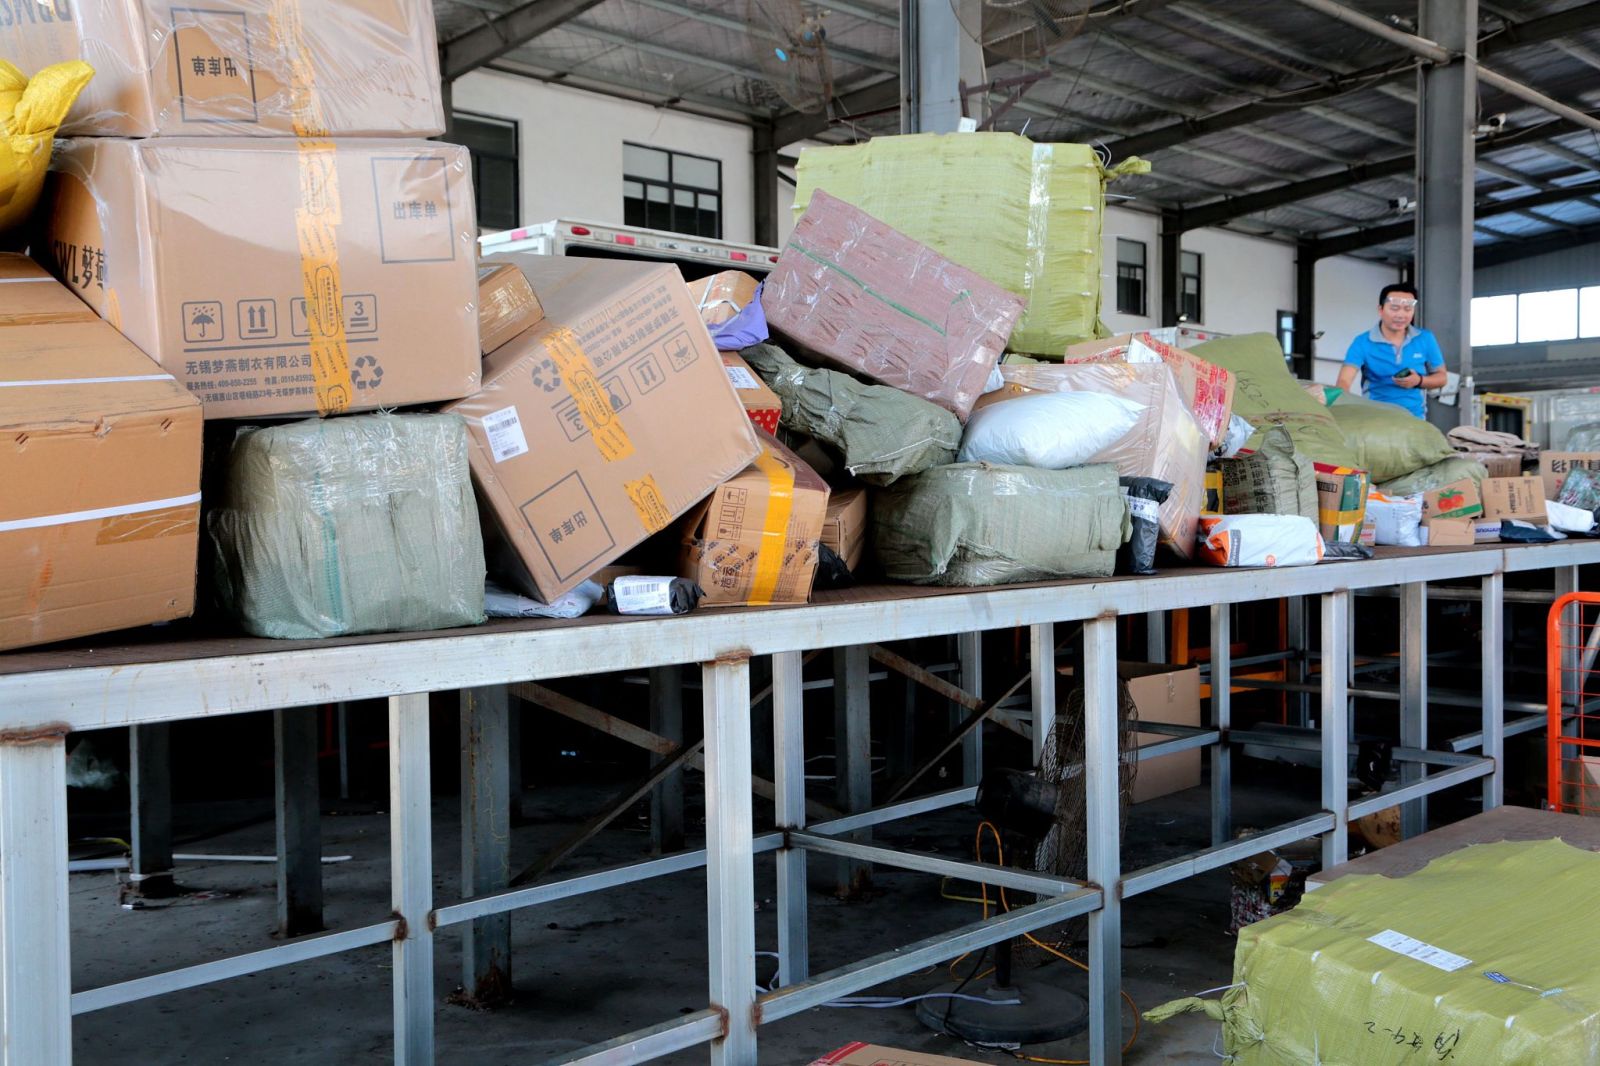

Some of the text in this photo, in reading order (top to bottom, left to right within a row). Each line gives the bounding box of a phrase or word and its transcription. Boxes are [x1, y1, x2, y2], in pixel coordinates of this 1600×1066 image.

[191, 56, 238, 77] 出库单
[393, 201, 438, 219] 出库单
[354, 301, 364, 315] 3
[185, 354, 312, 375] 无锡梦燕制衣有限公司
[573, 418, 584, 431] 3
[549, 510, 588, 544] 出库单
